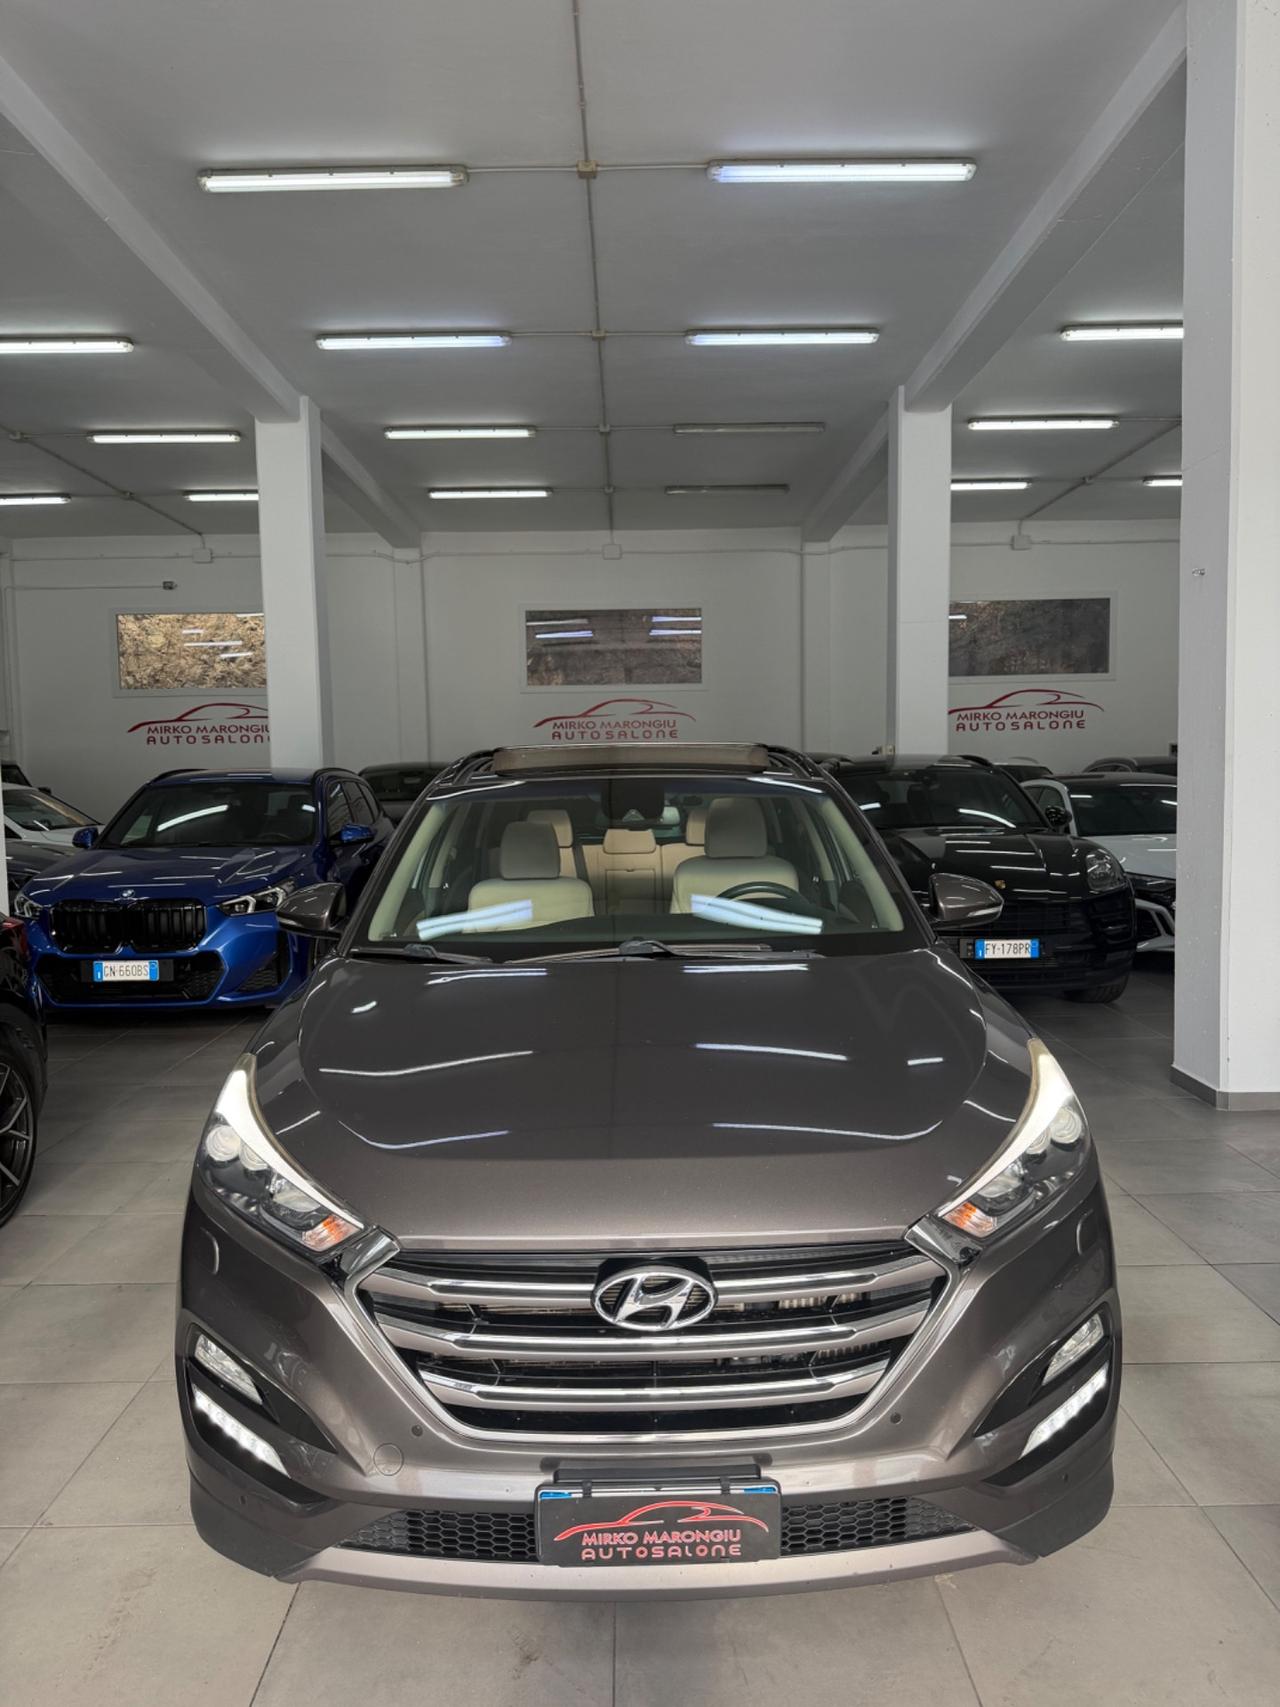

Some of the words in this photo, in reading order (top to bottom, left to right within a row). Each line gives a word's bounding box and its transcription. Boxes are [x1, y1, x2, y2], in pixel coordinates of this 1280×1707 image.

[957, 711, 1002, 721] MIRKO
[1005, 710, 1085, 720] MARONGIU
[147, 725, 192, 735] MIRKO
[552, 720, 596, 730] MIRKO
[600, 719, 677, 729] MARONGIU
[955, 720, 1086, 732] AUTOSALONE
[146, 734, 270, 745] AUTOSALON
[551, 729, 679, 741] AUTOSALONE
[582, 1531, 639, 1546] MIRKO
[643, 1529, 741, 1544] MARONGIU
[581, 1544, 742, 1561] AUTOSALONE
